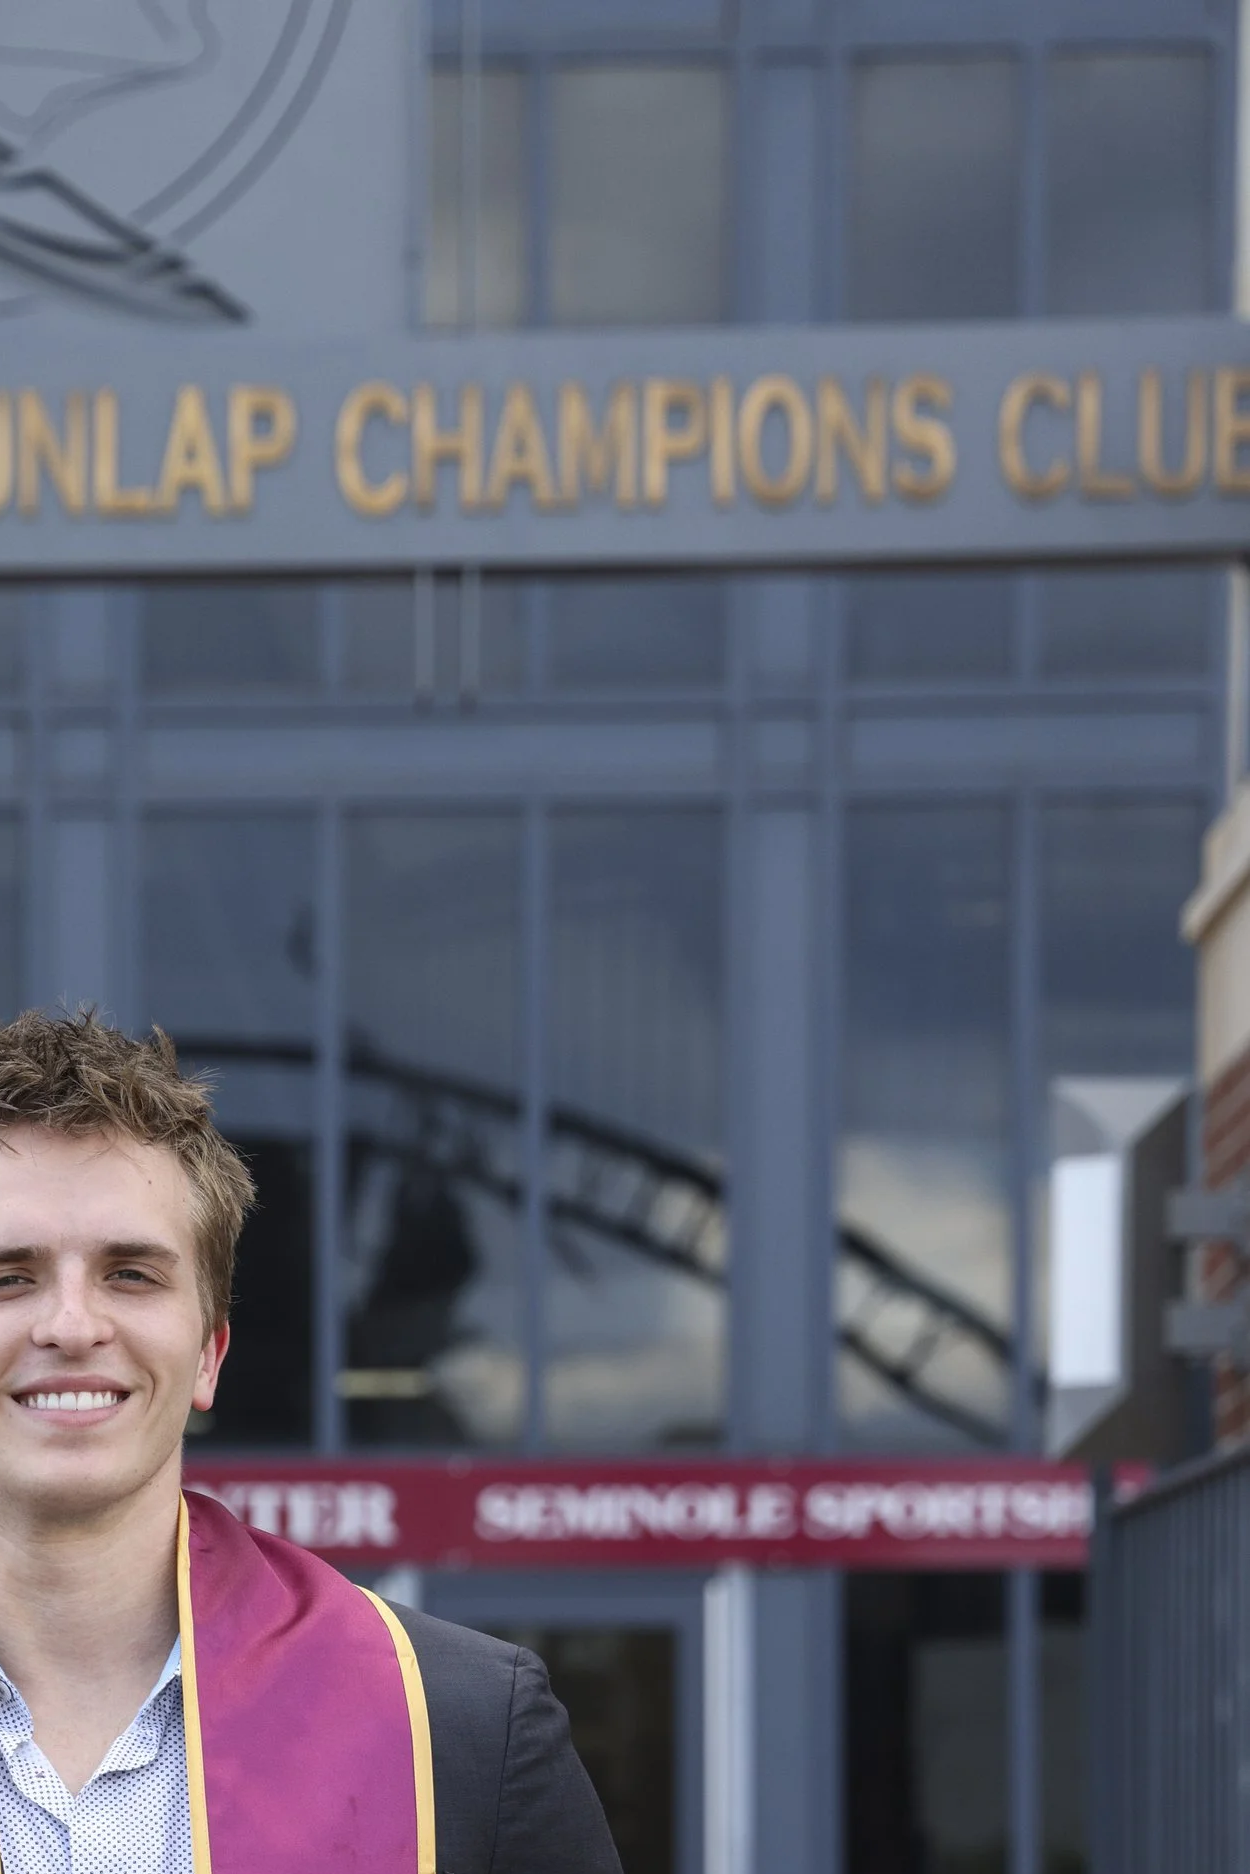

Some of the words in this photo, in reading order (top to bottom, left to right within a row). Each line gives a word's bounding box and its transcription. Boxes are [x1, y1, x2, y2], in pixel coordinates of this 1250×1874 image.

[334, 373, 958, 517] CHAMPIONS
[186, 1481, 399, 1549] TER
[473, 1483, 797, 1542] SEMINOLE
[802, 1481, 1096, 1540] SPORTSH
